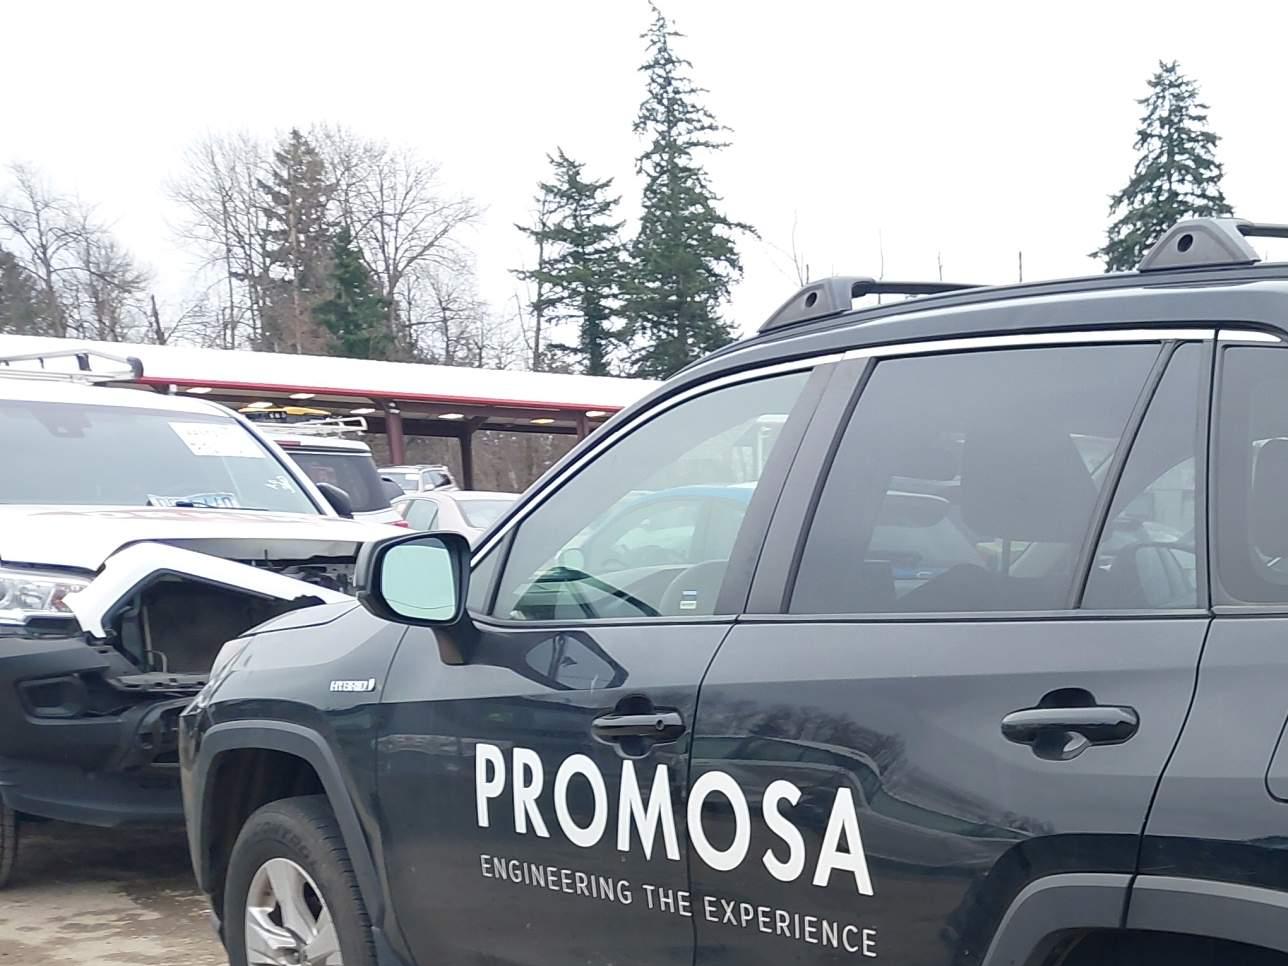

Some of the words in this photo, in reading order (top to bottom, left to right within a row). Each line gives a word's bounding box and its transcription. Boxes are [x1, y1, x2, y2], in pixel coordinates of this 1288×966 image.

[475, 743, 874, 896] PROMOSA
[480, 854, 633, 905] ENGINEERING
[642, 884, 692, 917] THE
[703, 896, 878, 958] EXPERIENCE
